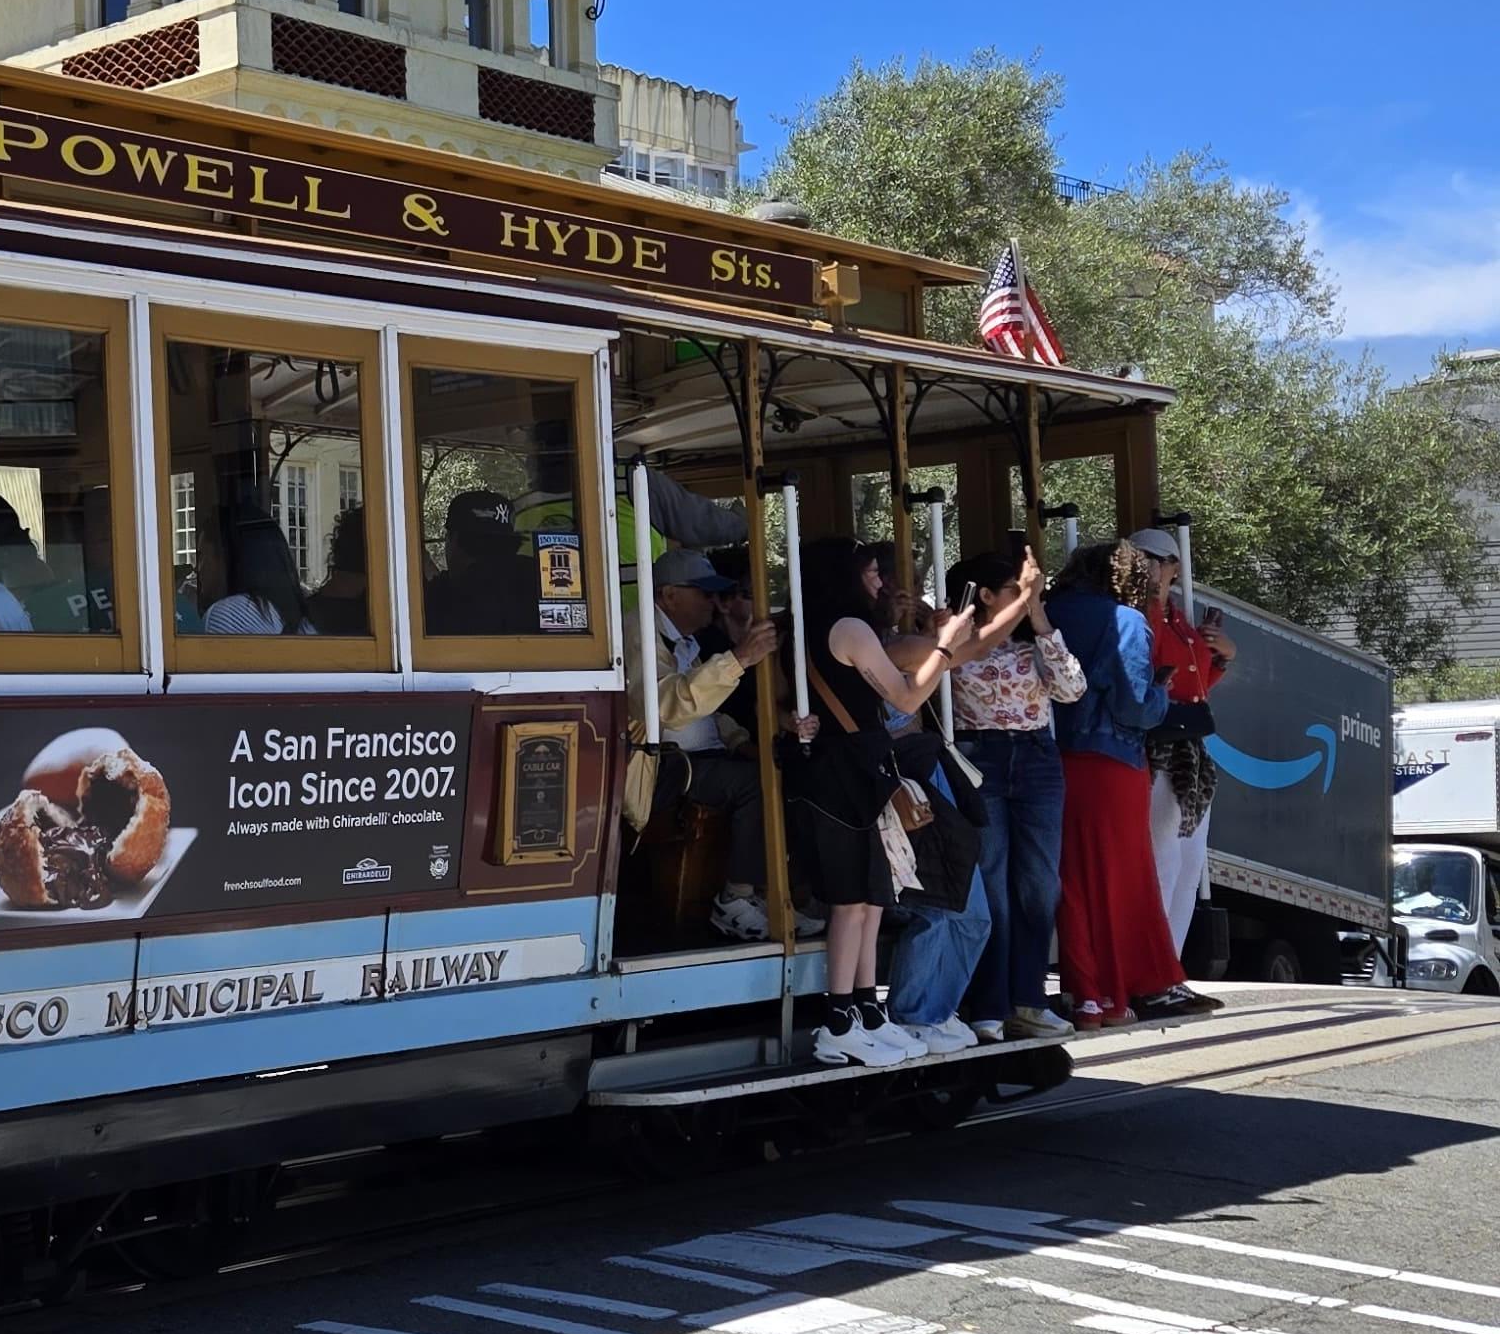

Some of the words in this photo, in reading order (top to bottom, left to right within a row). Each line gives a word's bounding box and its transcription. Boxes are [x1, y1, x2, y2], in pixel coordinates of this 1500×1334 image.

[402, 193, 450, 237] &
[500, 211, 667, 274] HYDE
[710, 250, 782, 290] Sts.
[495, 503, 510, 524] NY
[229, 729, 254, 763] A
[263, 728, 317, 762] San
[326, 724, 457, 760] Francisco
[1340, 712, 1381, 749] prime
[228, 776, 291, 809] Icon
[300, 770, 376, 805] Since
[384, 765, 456, 801] 2007.
[227, 820, 269, 837] Always
[271, 817, 303, 834] made
[305, 815, 330, 831] with
[391, 809, 445, 824] chocolate.
[223, 875, 302, 892] frenchsoulfood.com
[345, 869, 389, 881] GHIRARDELLI
[104, 969, 325, 1028] MUNICIPAL
[361, 949, 510, 998] RAILWAY
